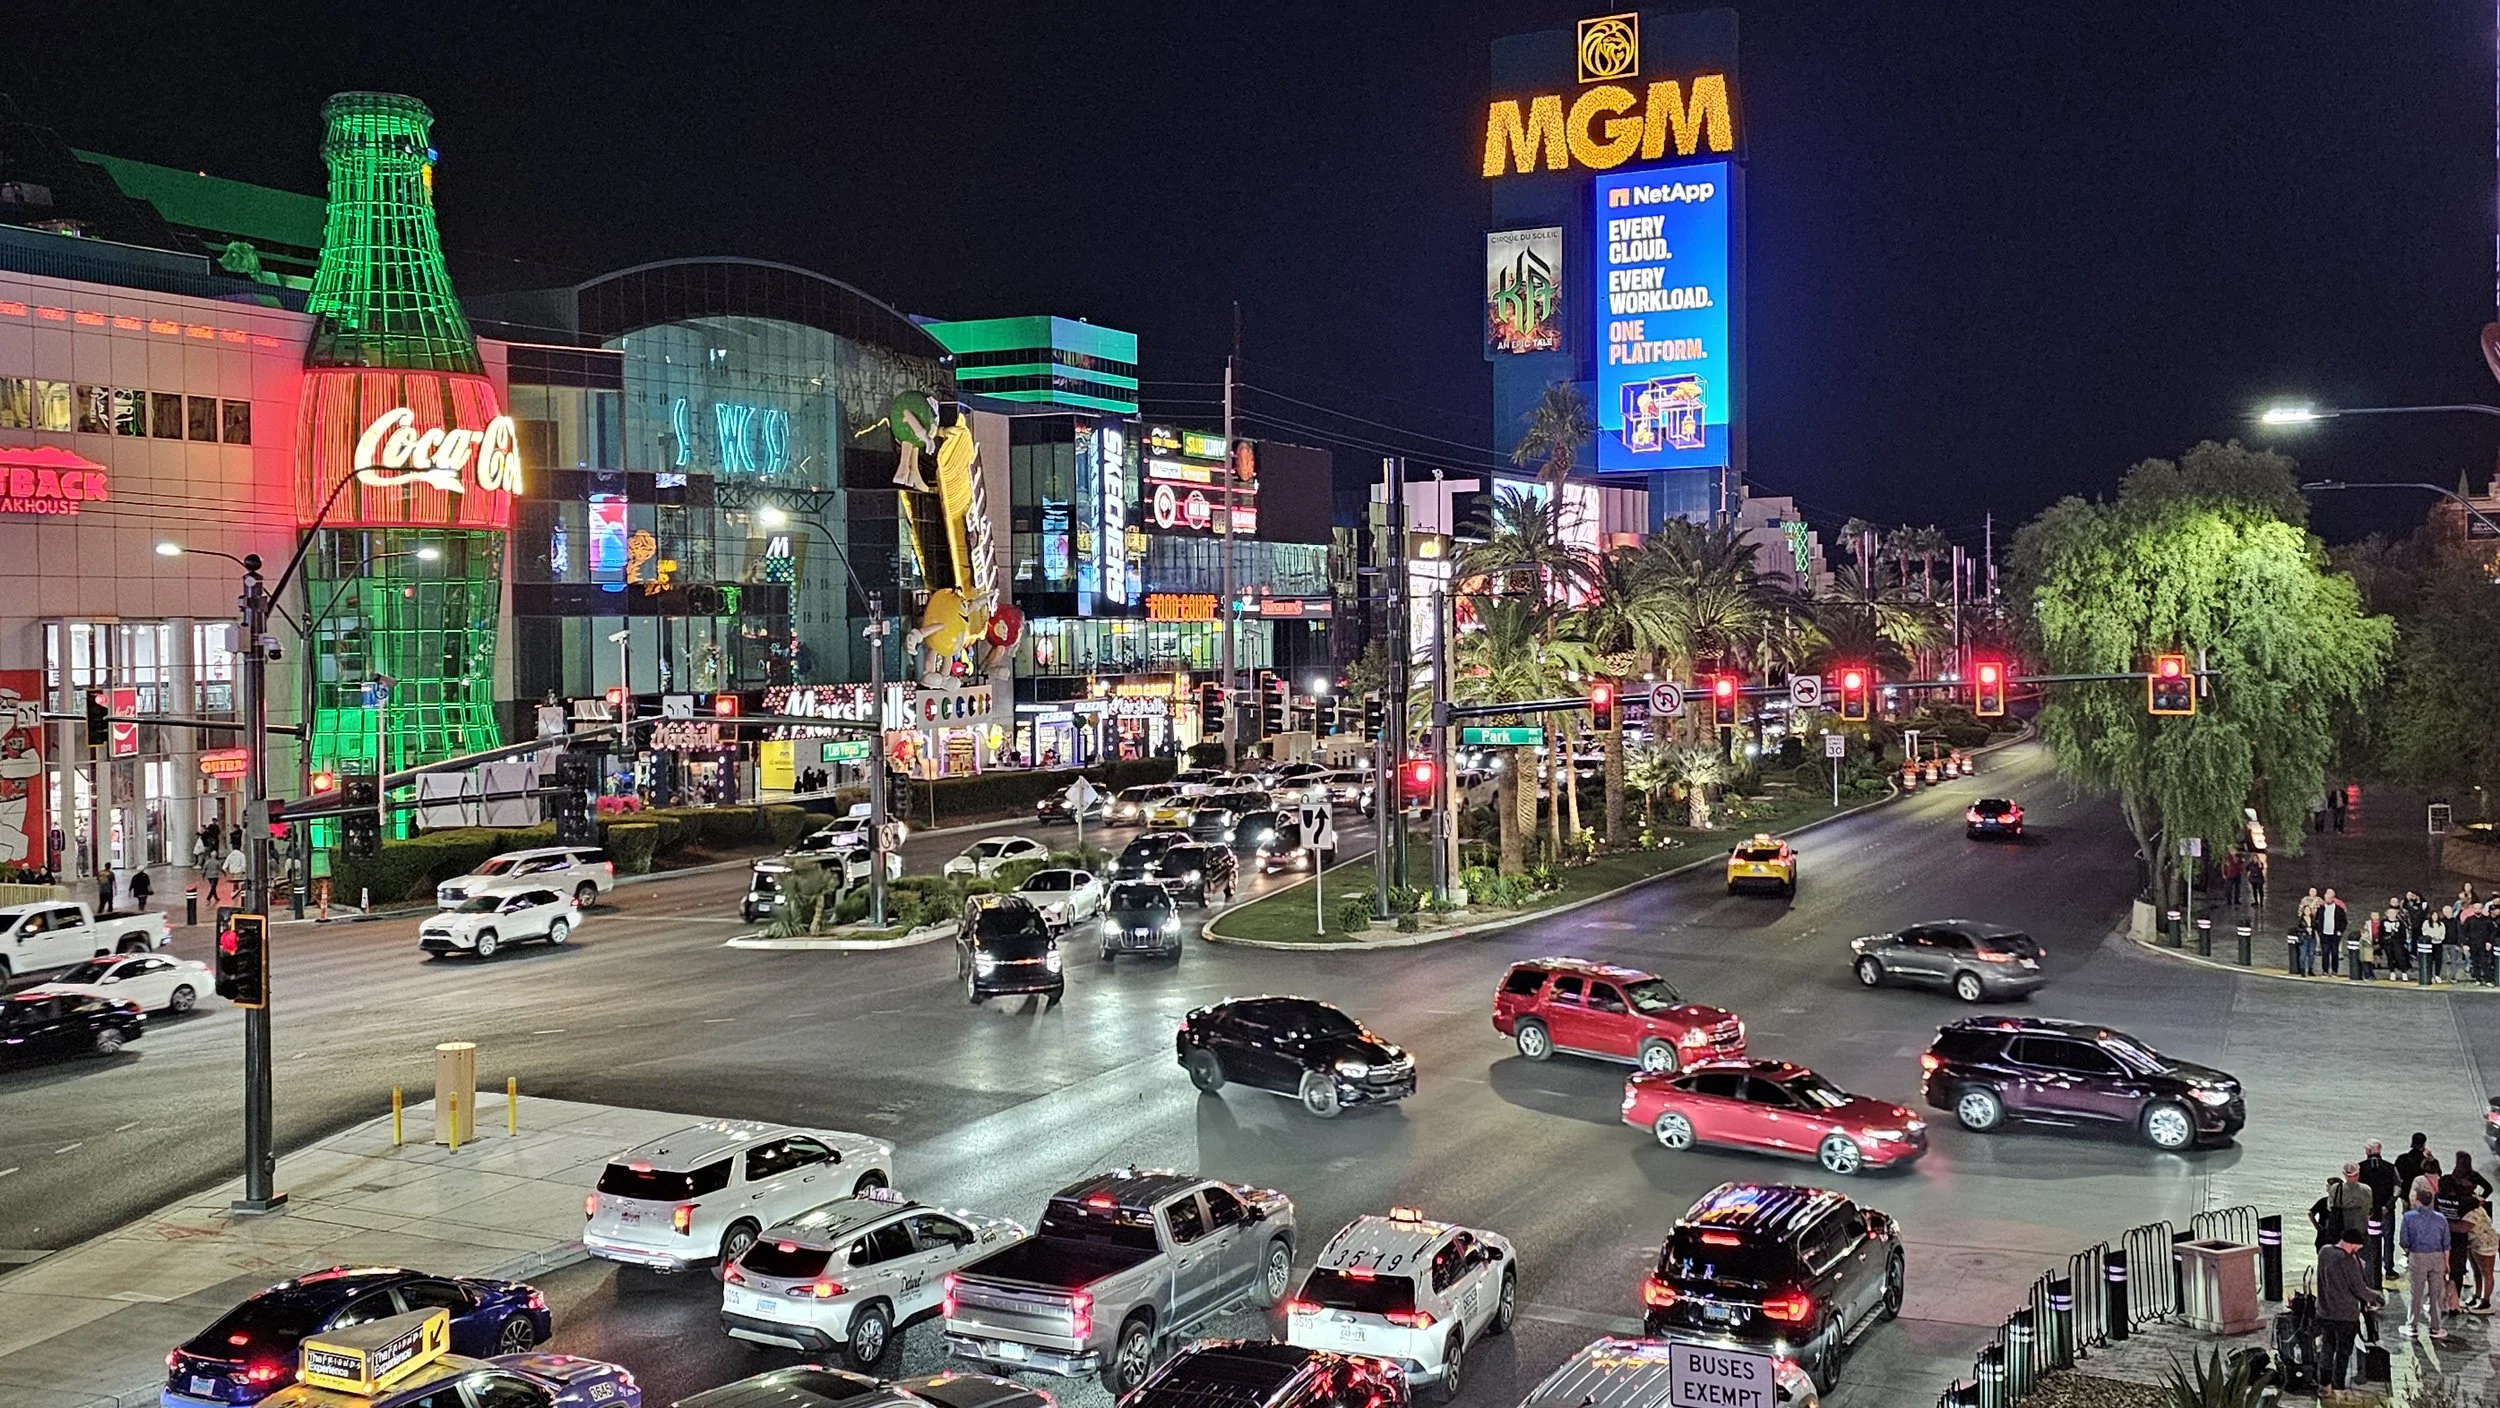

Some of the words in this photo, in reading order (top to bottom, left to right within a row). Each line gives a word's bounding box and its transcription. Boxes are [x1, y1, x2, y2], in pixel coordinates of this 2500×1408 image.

[1482, 74, 1733, 179] MGM
[1633, 182, 1714, 205] NetApp
[1491, 234, 1518, 244] CIRQUE
[1520, 233, 1531, 241] DU
[1608, 215, 1665, 242] EVERY
[1608, 238, 1673, 264] CLOUD.
[1608, 267, 1665, 292] EVERY
[1608, 286, 1714, 315] WORKLOAD.
[1608, 319, 1645, 343] ONE
[1497, 341, 1510, 350] AN
[1608, 338, 1708, 365] PLATFORM.
[1103, 427, 1126, 606] SKECHERS
[1150, 594, 1179, 618] FOOD
[1181, 594, 1216, 619] COURT
[1112, 697, 1167, 715] Marshalls
[1481, 729, 1511, 743] Park
[1828, 746, 1842, 755] 30
[1334, 1249, 1403, 1272] 3519
[308, 1362, 349, 1378] Experience
[1689, 1354, 1755, 1380] BUSES
[590, 1383, 613, 1400] 3645
[1684, 1381, 1762, 1408] EXEMPT
